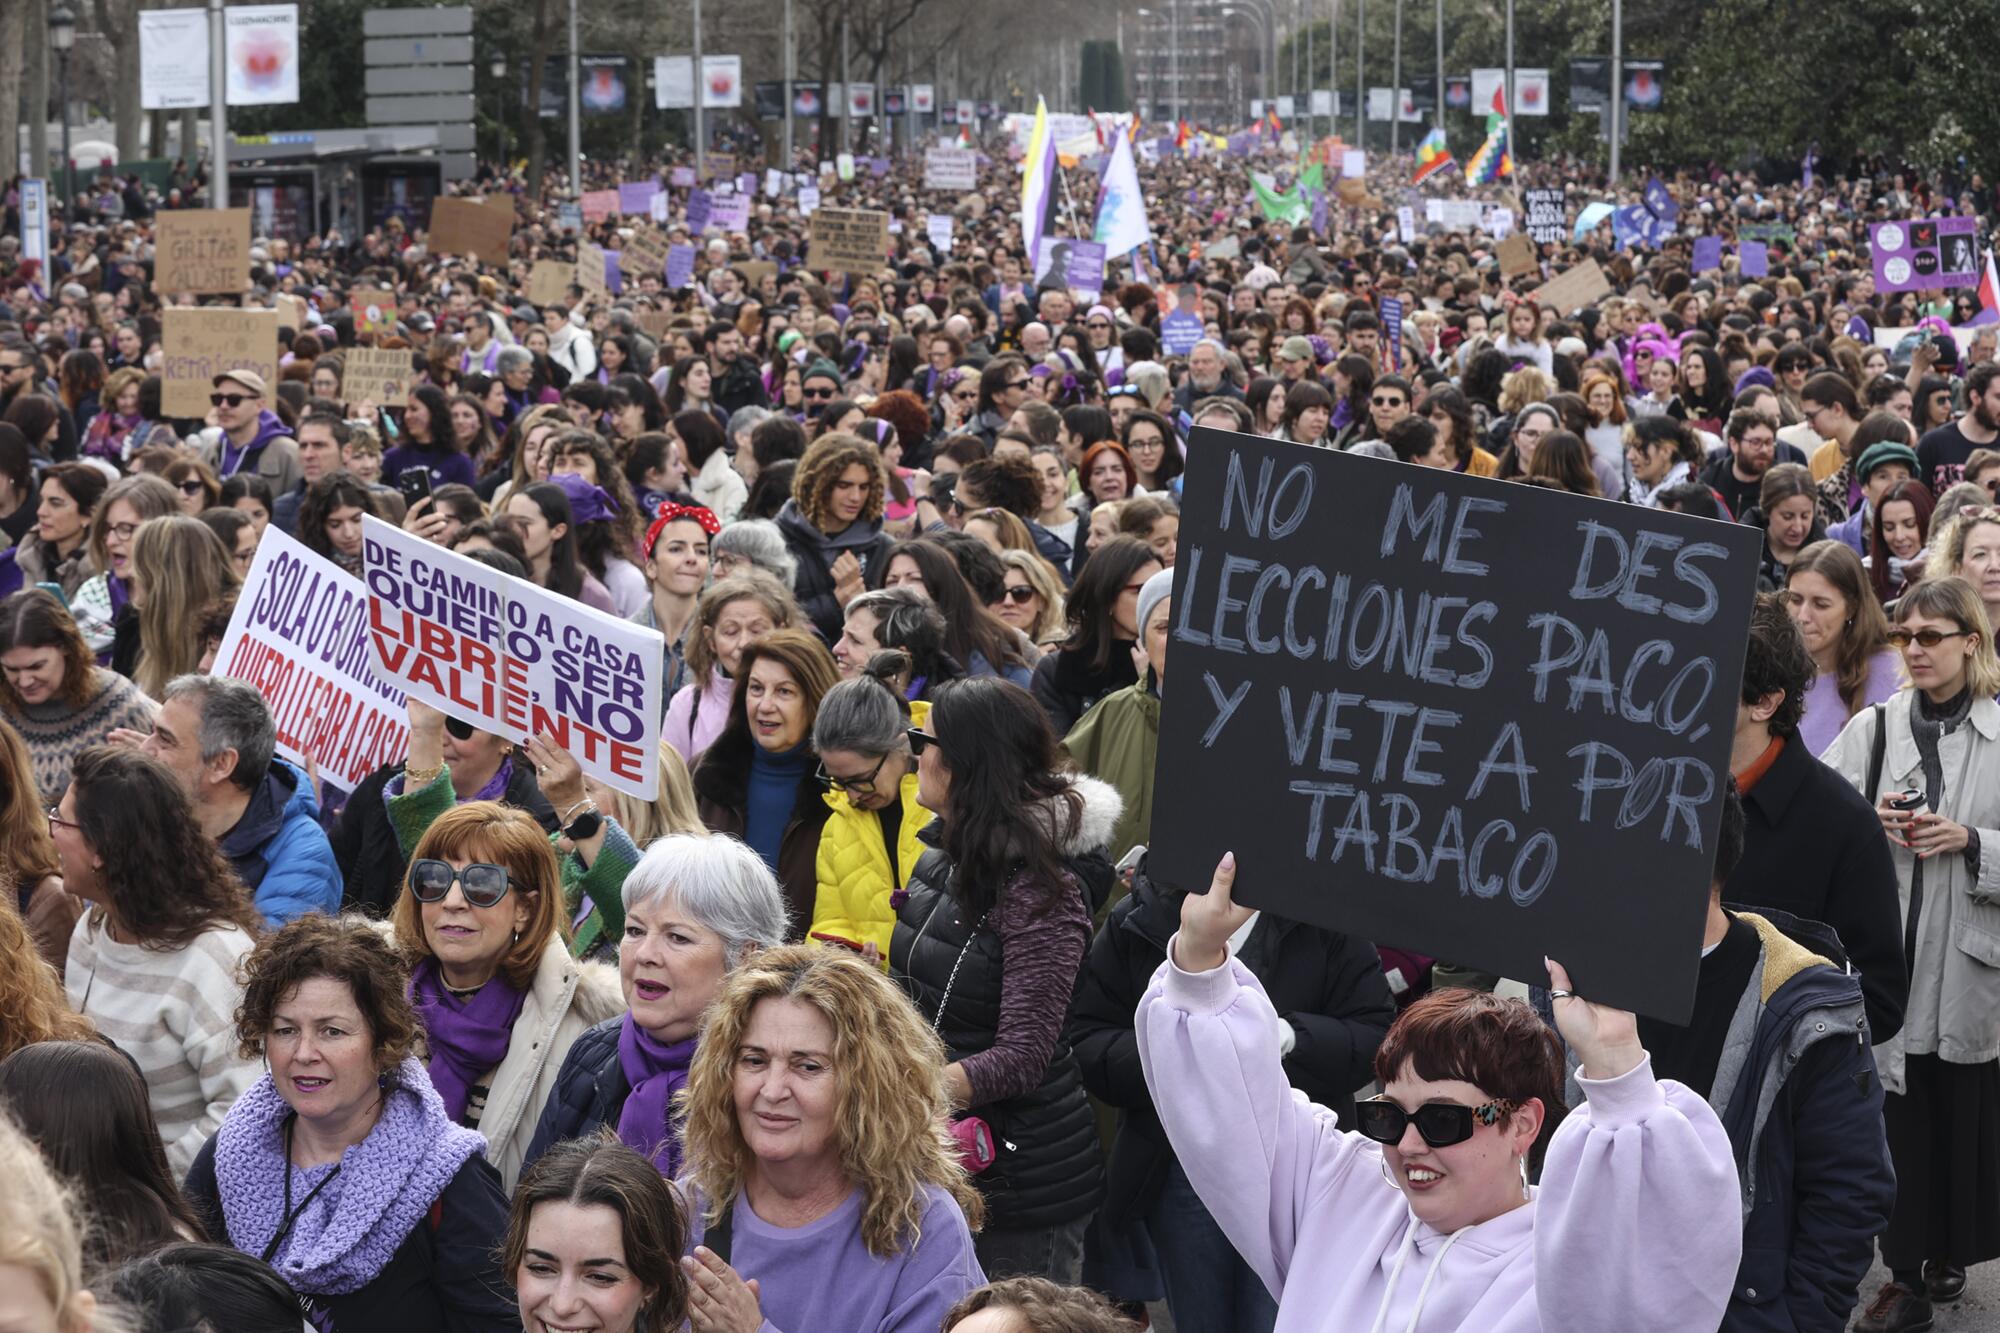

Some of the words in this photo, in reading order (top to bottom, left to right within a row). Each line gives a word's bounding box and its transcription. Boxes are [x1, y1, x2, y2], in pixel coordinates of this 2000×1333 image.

[171, 239, 238, 260] GRITAR
[245, 551, 322, 646] ¡SOLA
[306, 580, 338, 655] O
[1220, 448, 1316, 541] NO
[1380, 482, 1508, 577] ME
[1569, 518, 1731, 626] DES
[365, 538, 402, 577] DE
[410, 559, 527, 629] CAMINO
[534, 613, 555, 644] A
[562, 625, 645, 681] CASA
[367, 568, 542, 664] QUIERO
[551, 649, 645, 711] SER
[369, 594, 540, 703] LIBRE,
[555, 677, 645, 743] NO
[1173, 544, 1499, 691] LECCIONES
[1526, 610, 1718, 744] PACO,
[275, 666, 352, 770] LLEGAR
[331, 701, 366, 778] A
[371, 629, 645, 784] VALIENTE
[1199, 669, 1253, 750] Y
[1277, 685, 1463, 787] VETE
[1465, 720, 1539, 814] A
[1566, 740, 1717, 855] POR
[1288, 779, 1559, 907] TABACO
